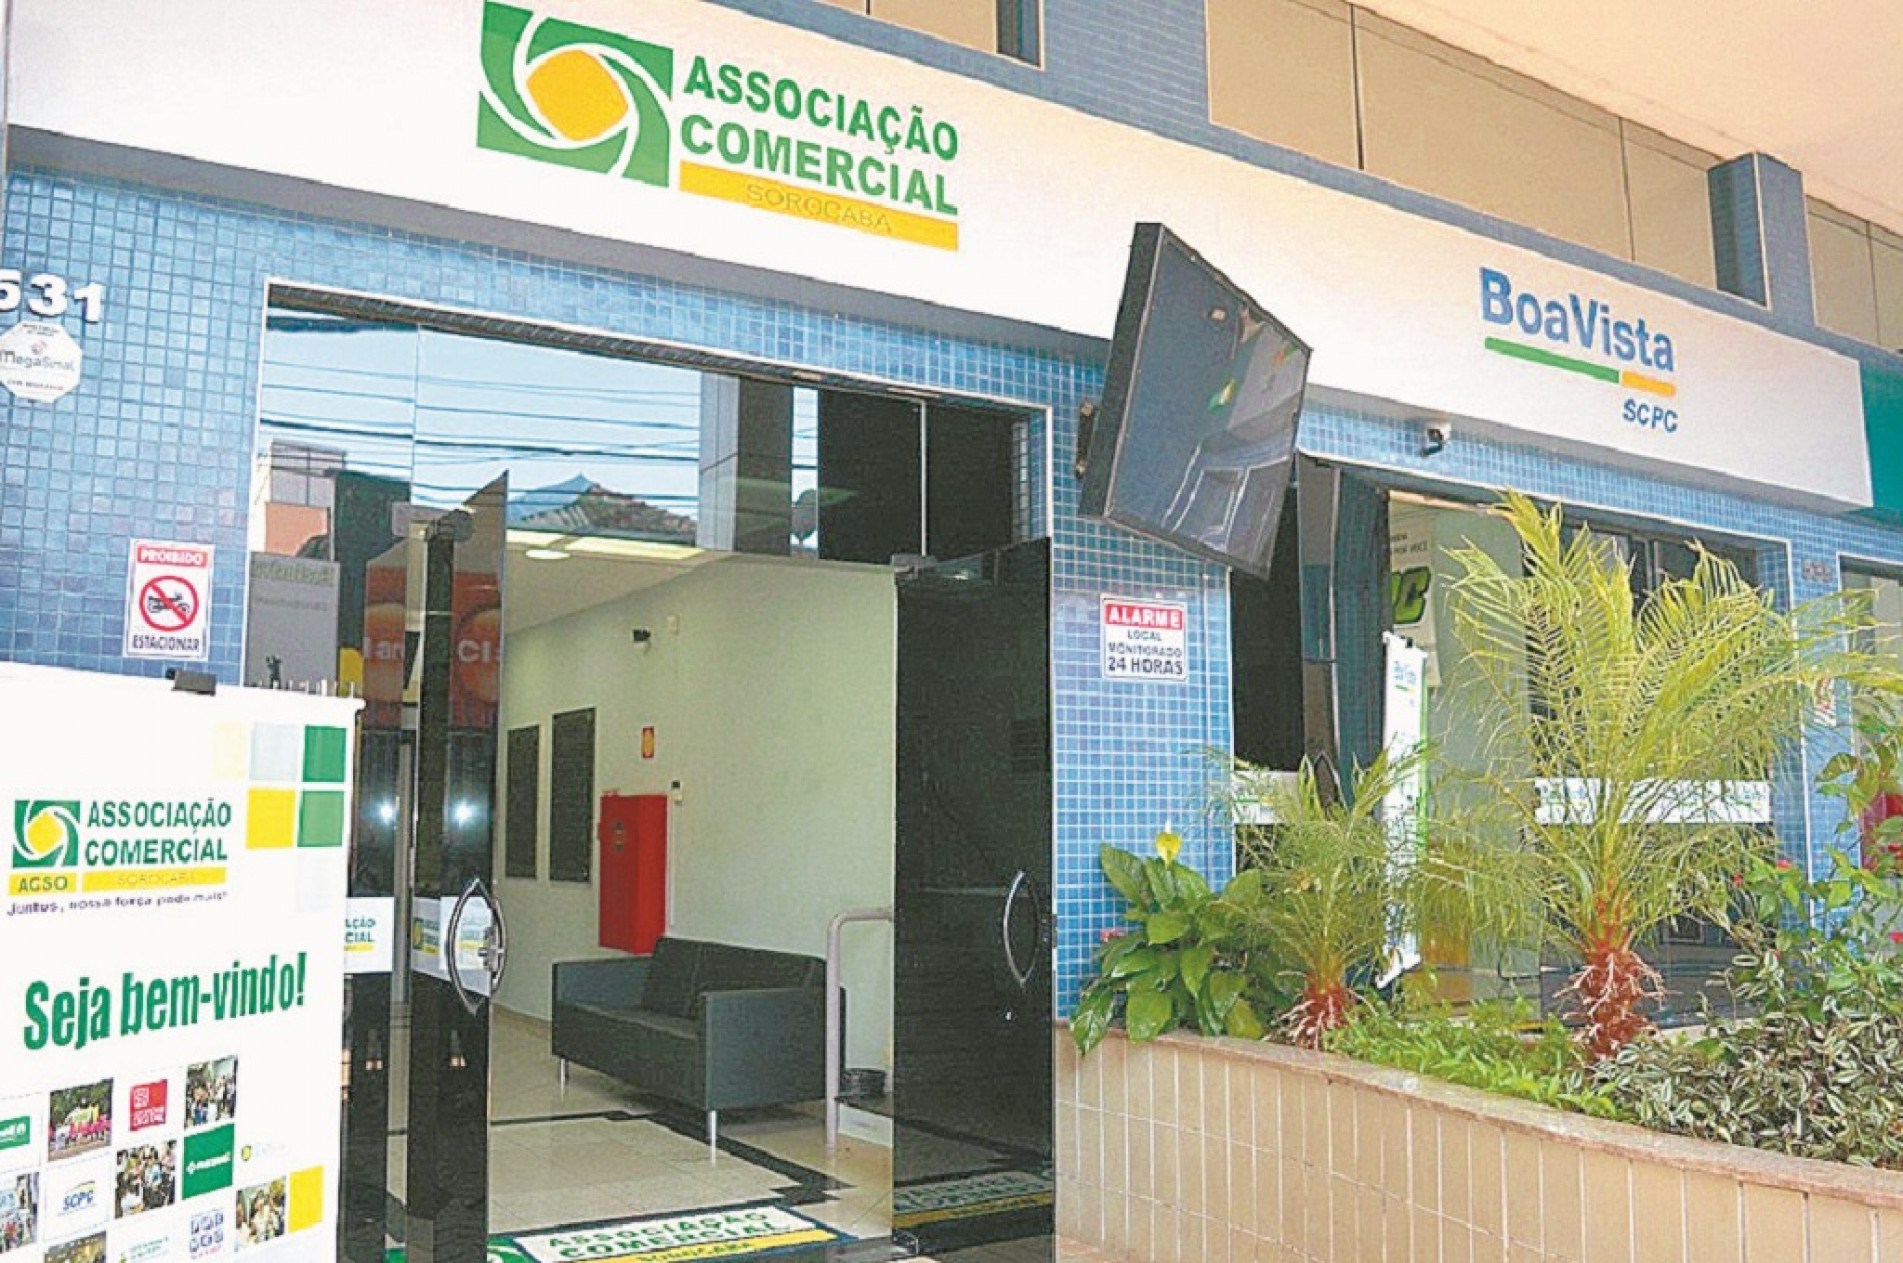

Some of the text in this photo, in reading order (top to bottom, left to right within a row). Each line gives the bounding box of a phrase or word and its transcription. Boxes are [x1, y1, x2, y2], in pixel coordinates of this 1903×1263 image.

[683, 55, 959, 162] ASSOCIAÇÃO
[681, 114, 959, 216] COMERCIAL
[745, 183, 893, 234] SOROCABA
[1480, 266, 1675, 373] BoaVista
[1622, 398, 1679, 434] SCPC
[140, 546, 202, 566] PROIBIDO
[1108, 605, 1181, 628] ALARME
[133, 633, 199, 652] ESTACIONAR
[1108, 642, 1183, 658] MONITORADO
[1127, 629, 1163, 642] LOCAL
[1108, 656, 1183, 675] 24 HORAS
[87, 797, 232, 834] ASSOCIAÇÃO
[85, 838, 229, 867] COMERCIAL
[23, 950, 307, 1051] Seja bem-vindo!
[557, 1220, 791, 1258] COMERCIAL
